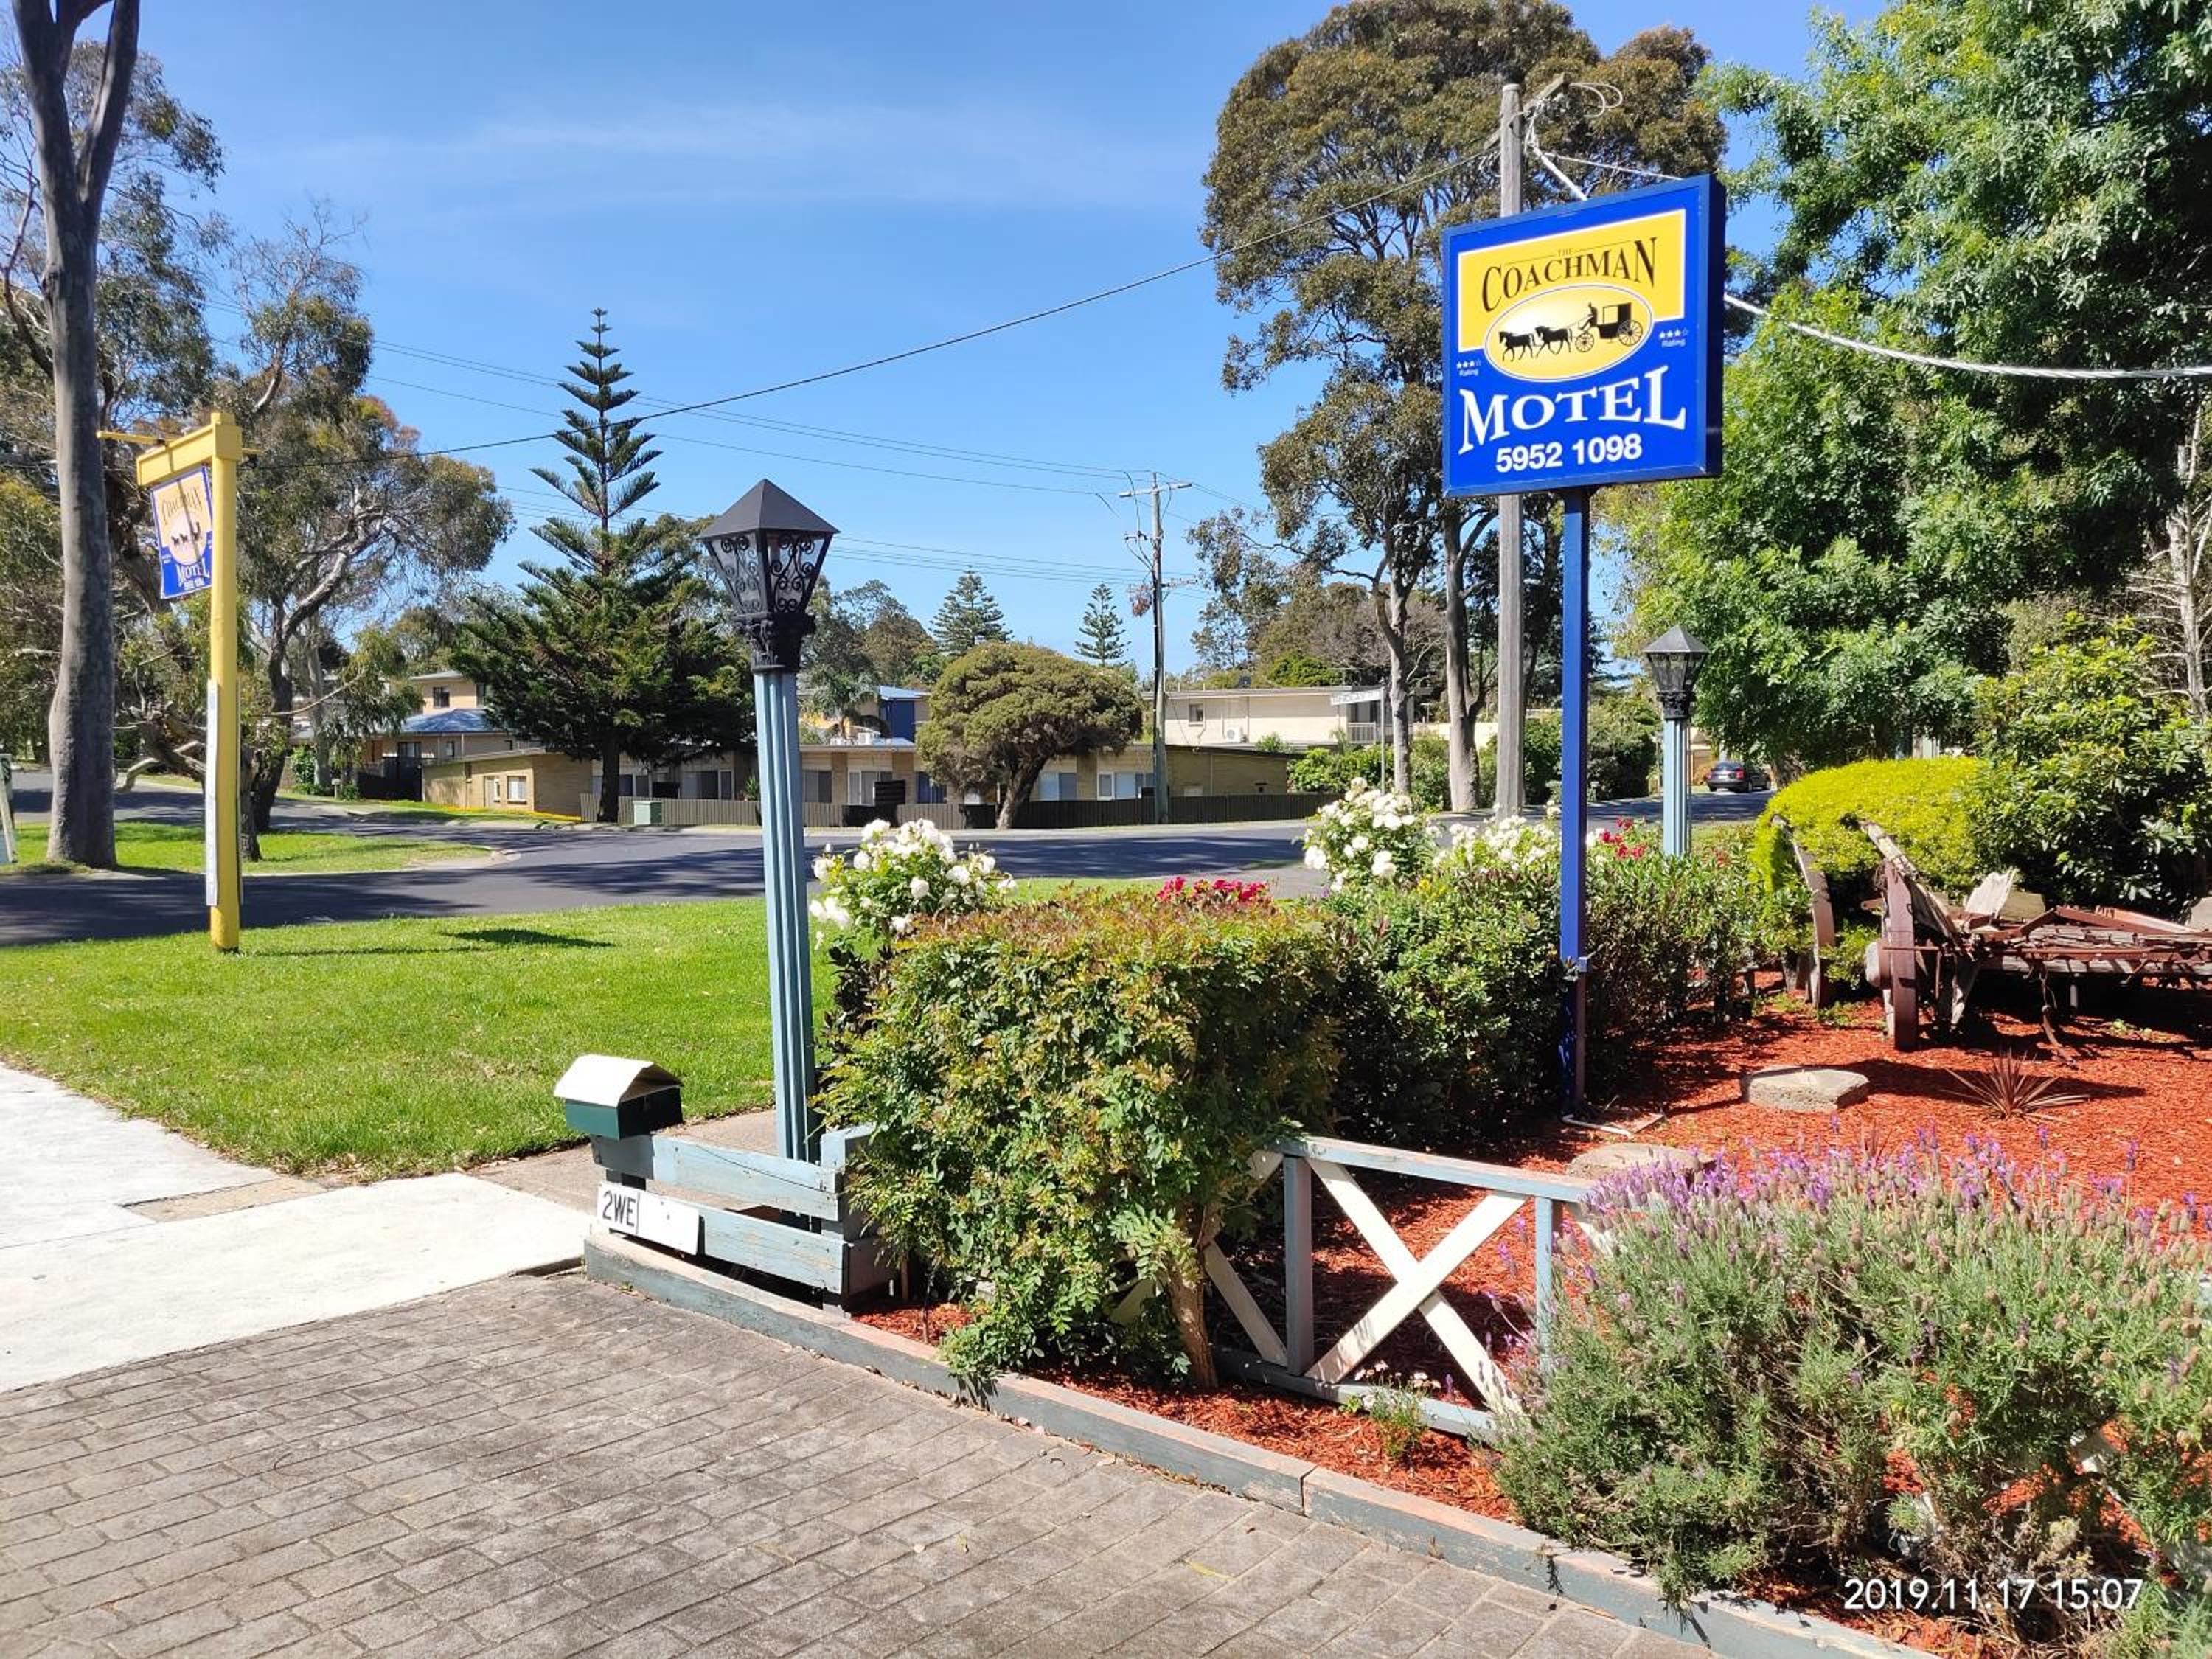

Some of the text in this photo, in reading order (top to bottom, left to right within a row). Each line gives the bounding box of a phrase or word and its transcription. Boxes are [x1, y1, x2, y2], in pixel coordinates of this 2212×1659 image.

[1557, 248, 1574, 257] THE
[1481, 236, 1658, 313] COACHMAN
[1458, 365, 1686, 455] MOTEL
[1495, 432, 1643, 473] 5952 1098
[602, 1189, 636, 1228] 2WE
